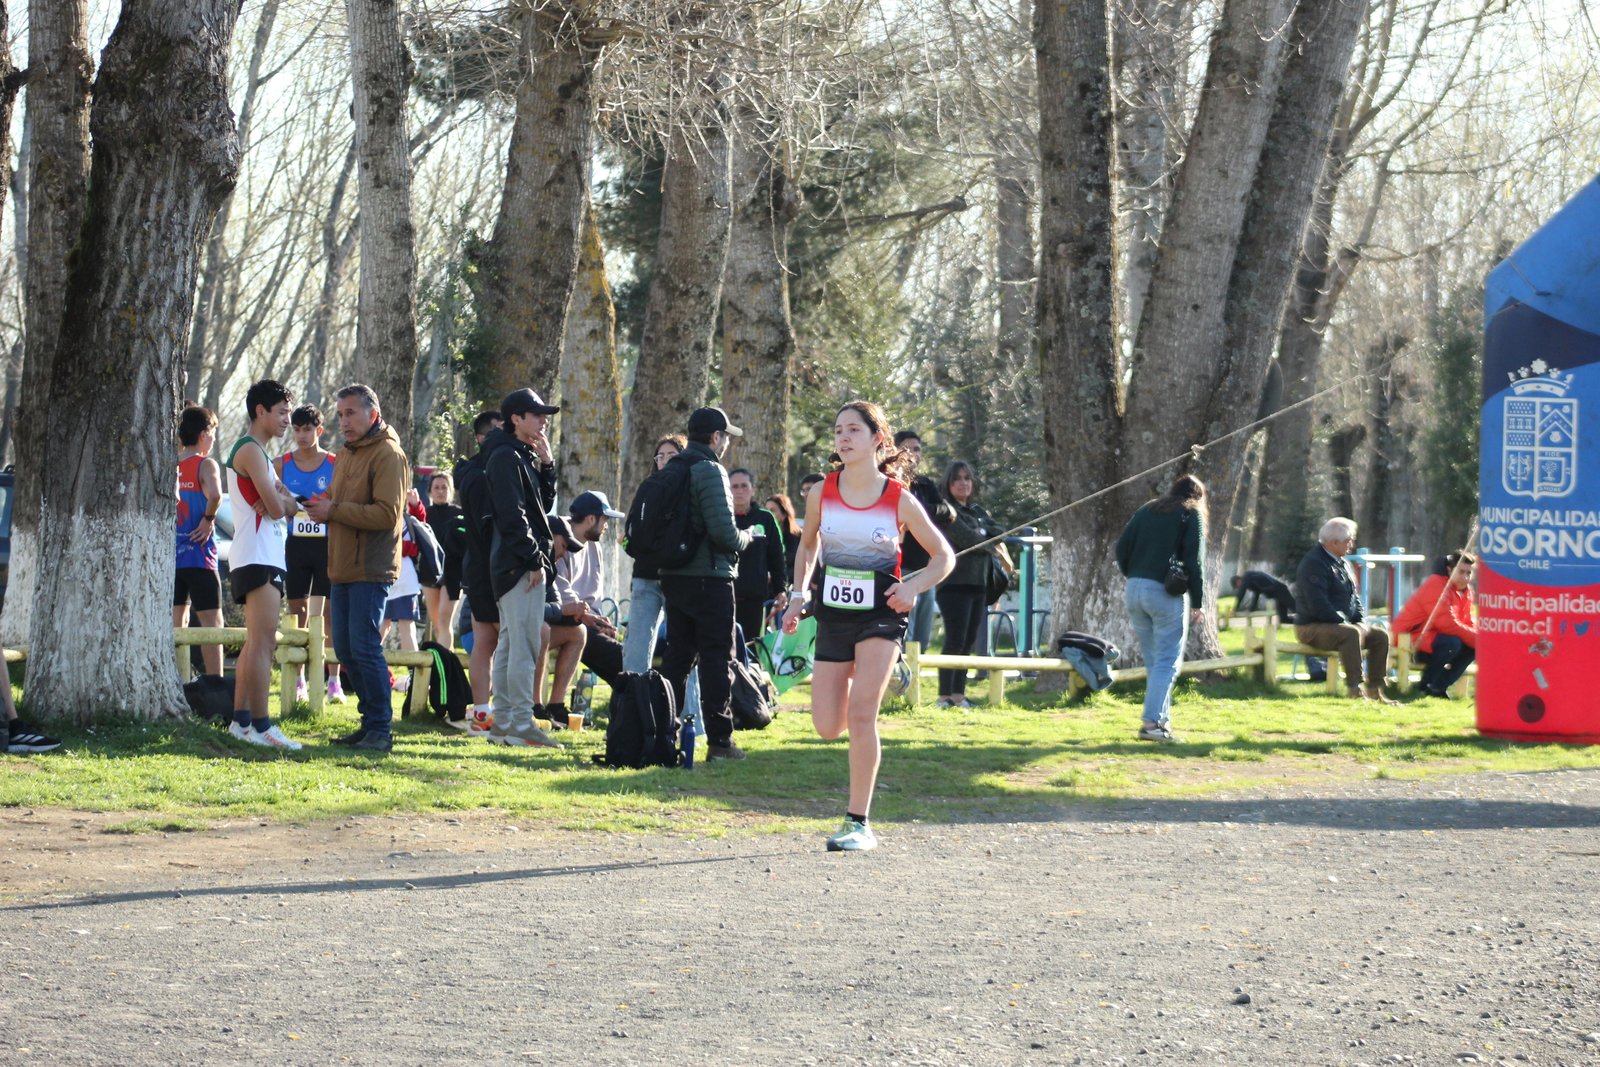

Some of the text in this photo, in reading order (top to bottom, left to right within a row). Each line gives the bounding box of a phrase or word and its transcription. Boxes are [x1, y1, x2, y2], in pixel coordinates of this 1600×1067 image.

[1480, 507, 1600, 527] MUNICIPALIDA
[298, 522, 320, 533] 006
[1518, 559, 1550, 569] CHILE
[830, 585, 864, 604] 050
[1478, 616, 1552, 635] osorno.cl
